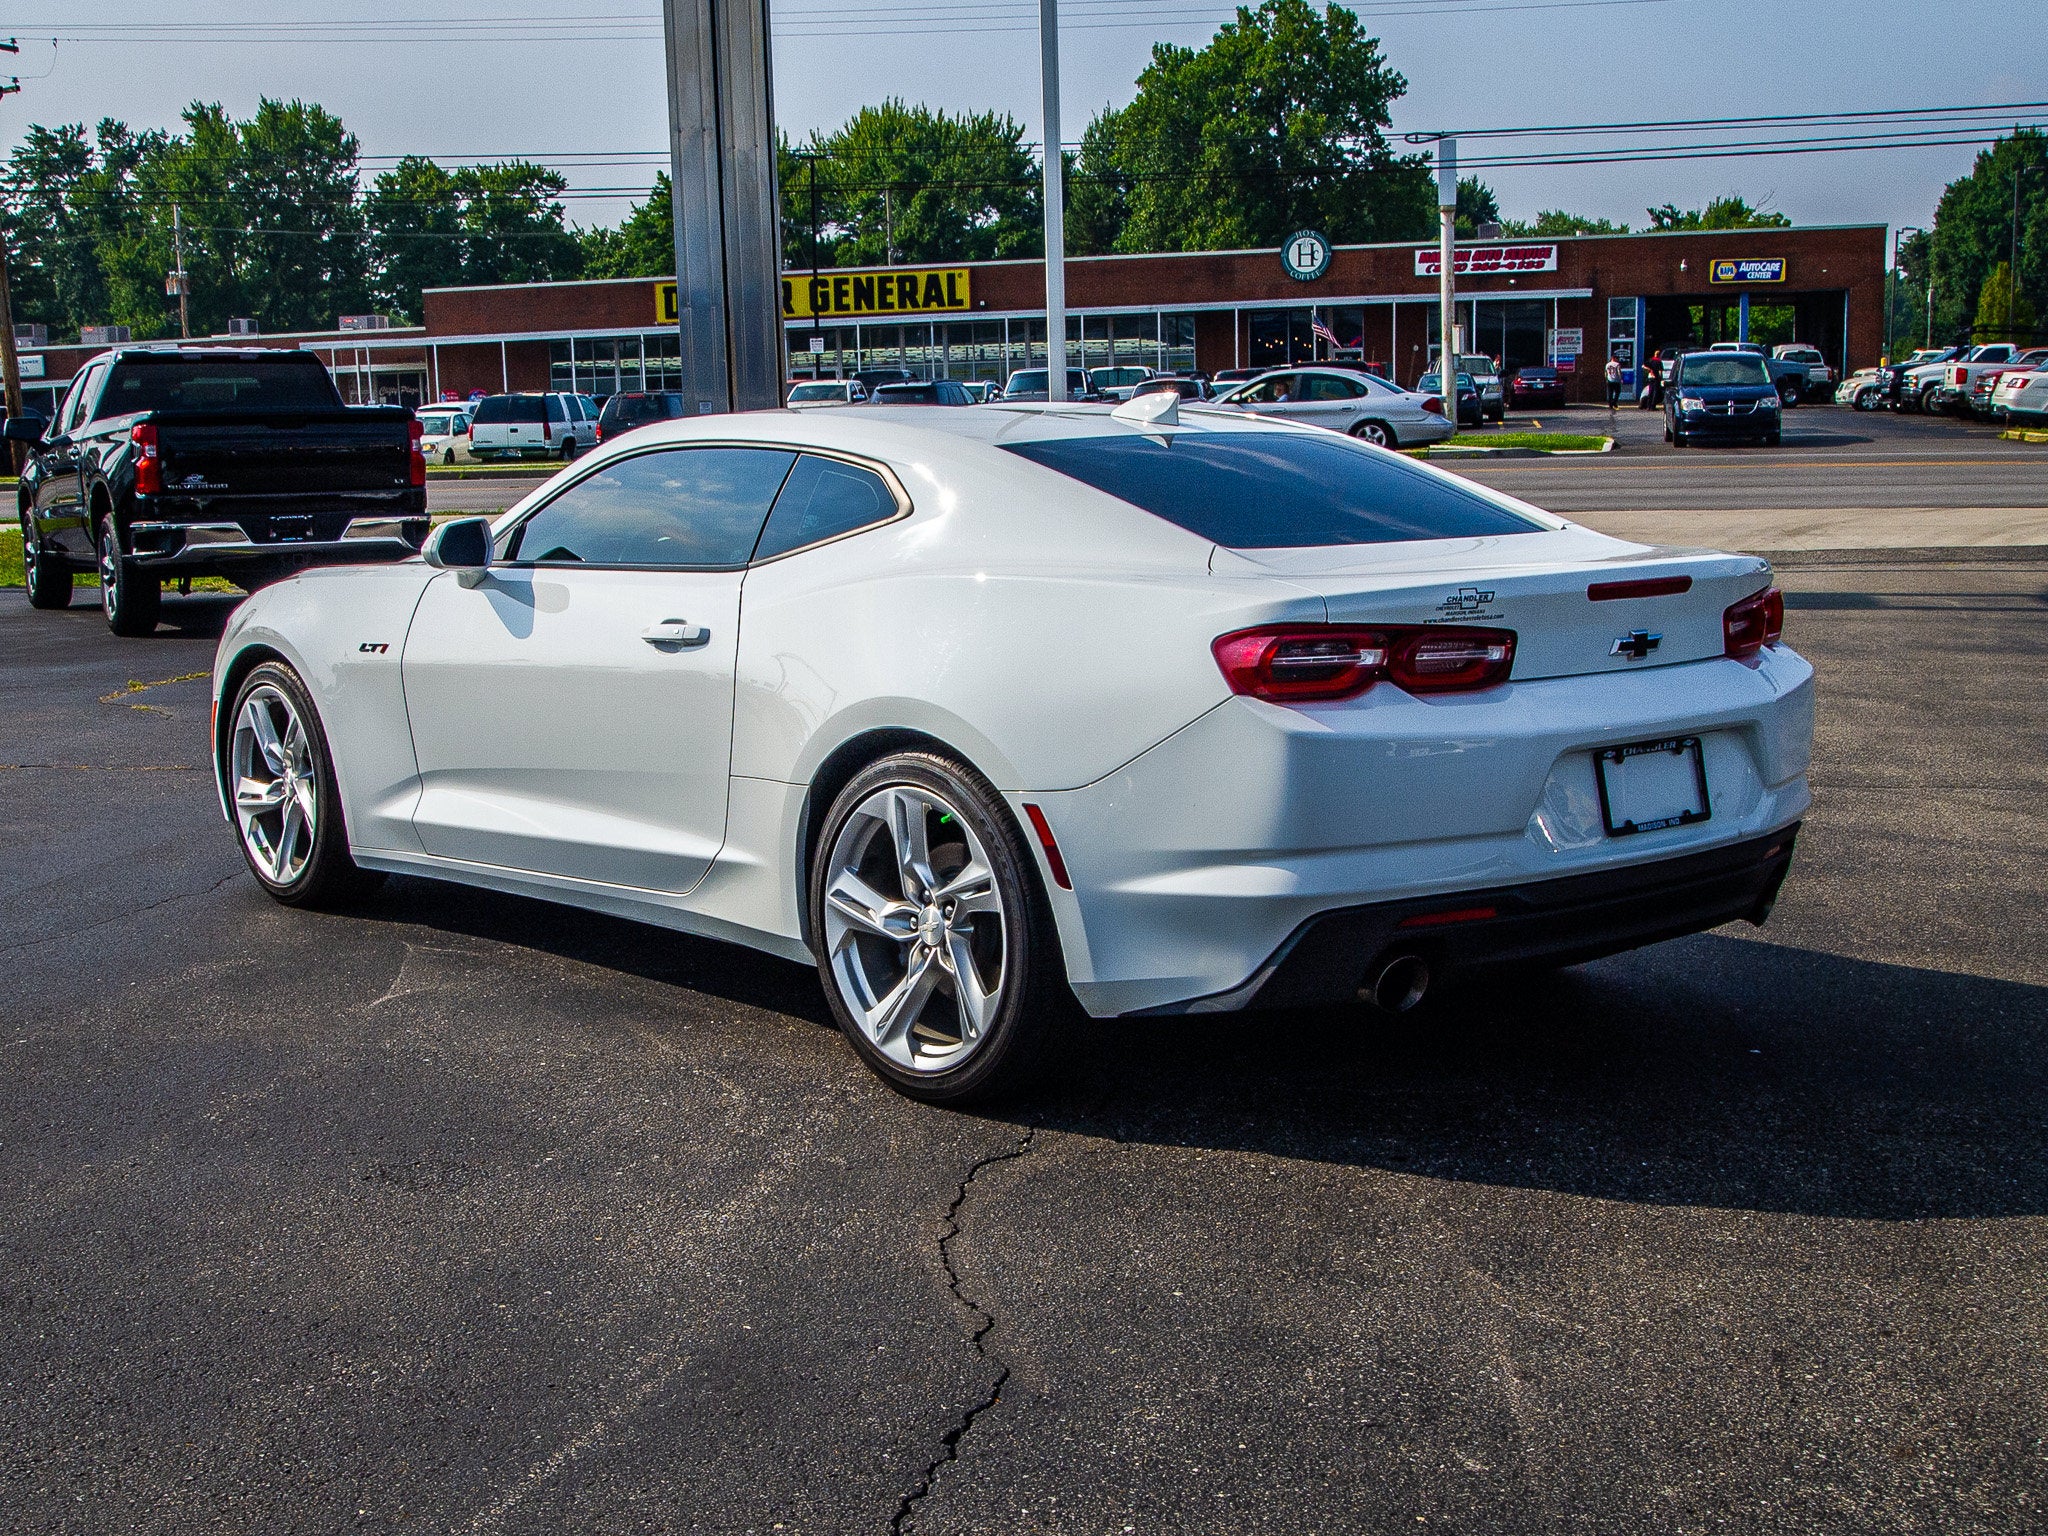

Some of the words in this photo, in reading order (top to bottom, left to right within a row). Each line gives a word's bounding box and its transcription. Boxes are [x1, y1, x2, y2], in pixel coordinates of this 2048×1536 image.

[1418, 250, 1472, 264] MAON
[1472, 249, 1504, 262] AUTO
[1503, 247, 1553, 261] SERVICE
[1290, 269, 1321, 280] COFFEE
[1747, 271, 1772, 279] CENTER
[809, 272, 964, 314] GENERAL
[1446, 594, 1489, 603] CHANDLER
[359, 643, 389, 654] LT1
